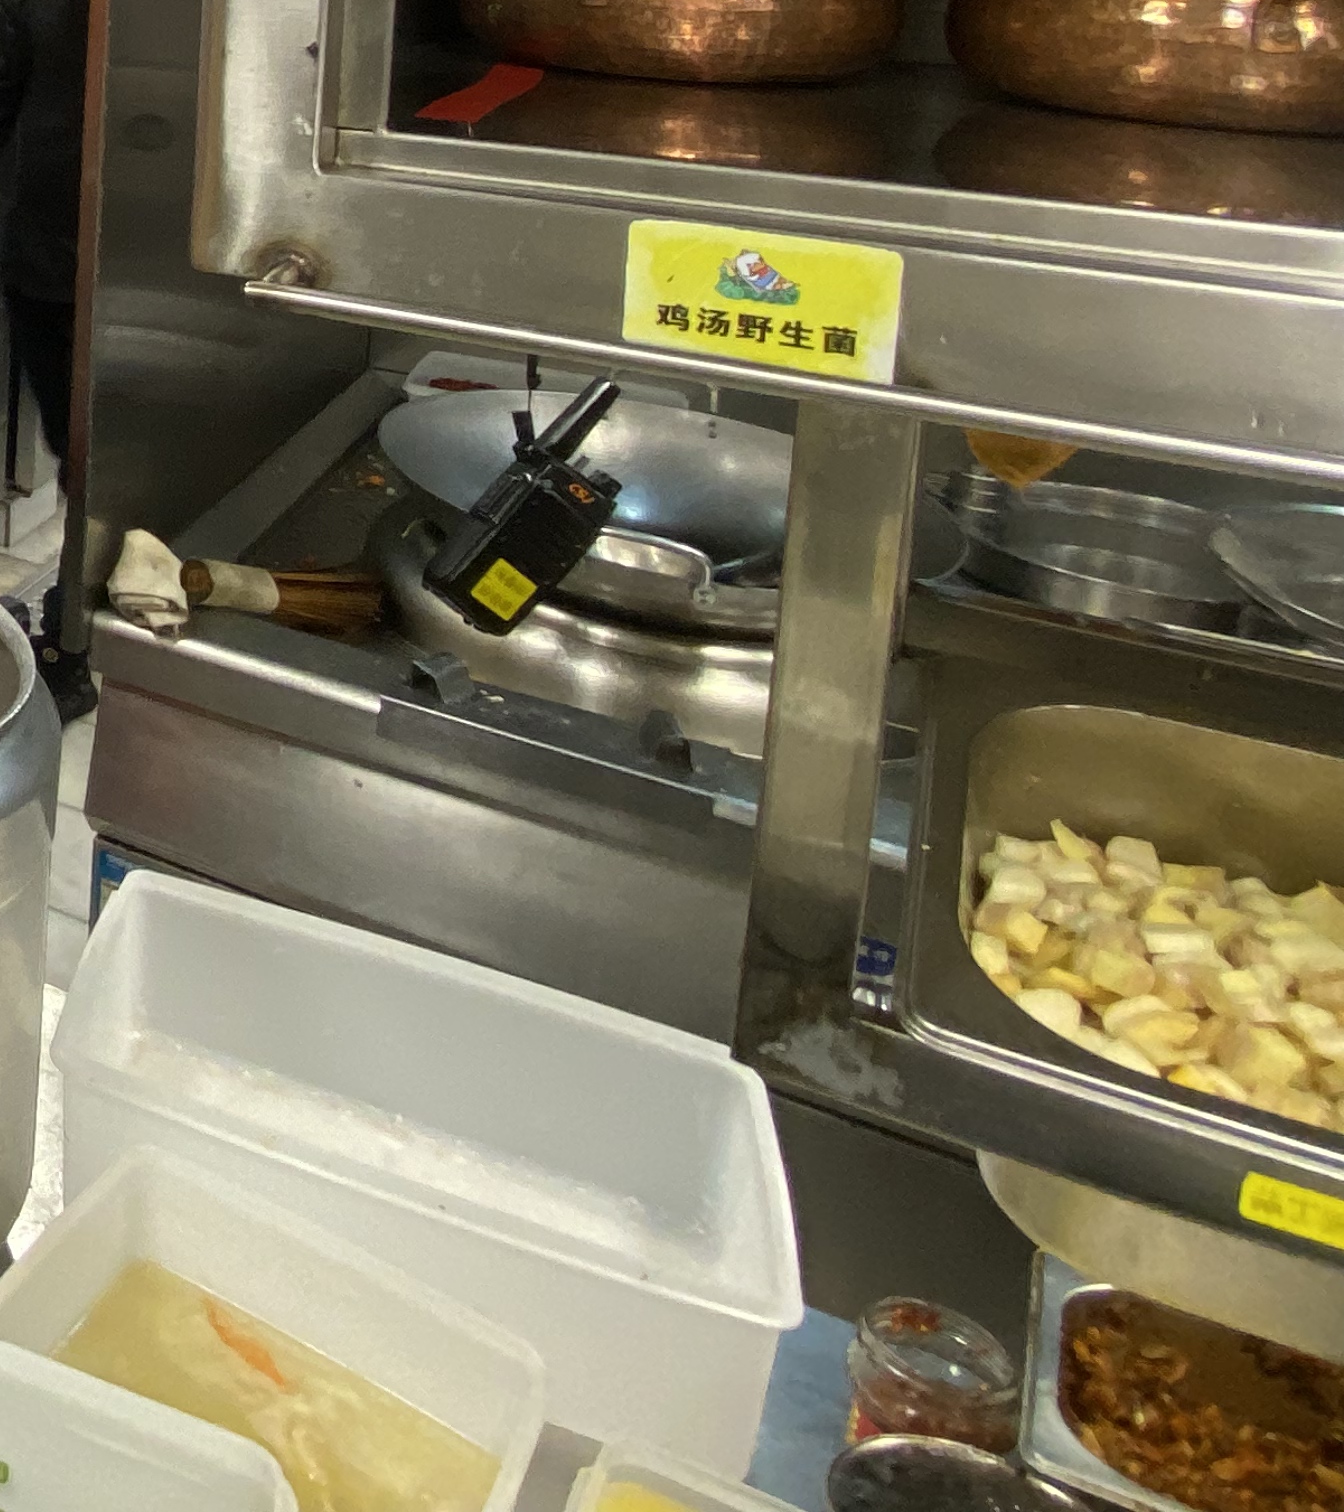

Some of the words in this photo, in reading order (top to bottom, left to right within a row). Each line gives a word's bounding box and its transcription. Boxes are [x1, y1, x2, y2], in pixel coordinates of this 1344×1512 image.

[656, 303, 858, 357] 鸡汤野生菌
